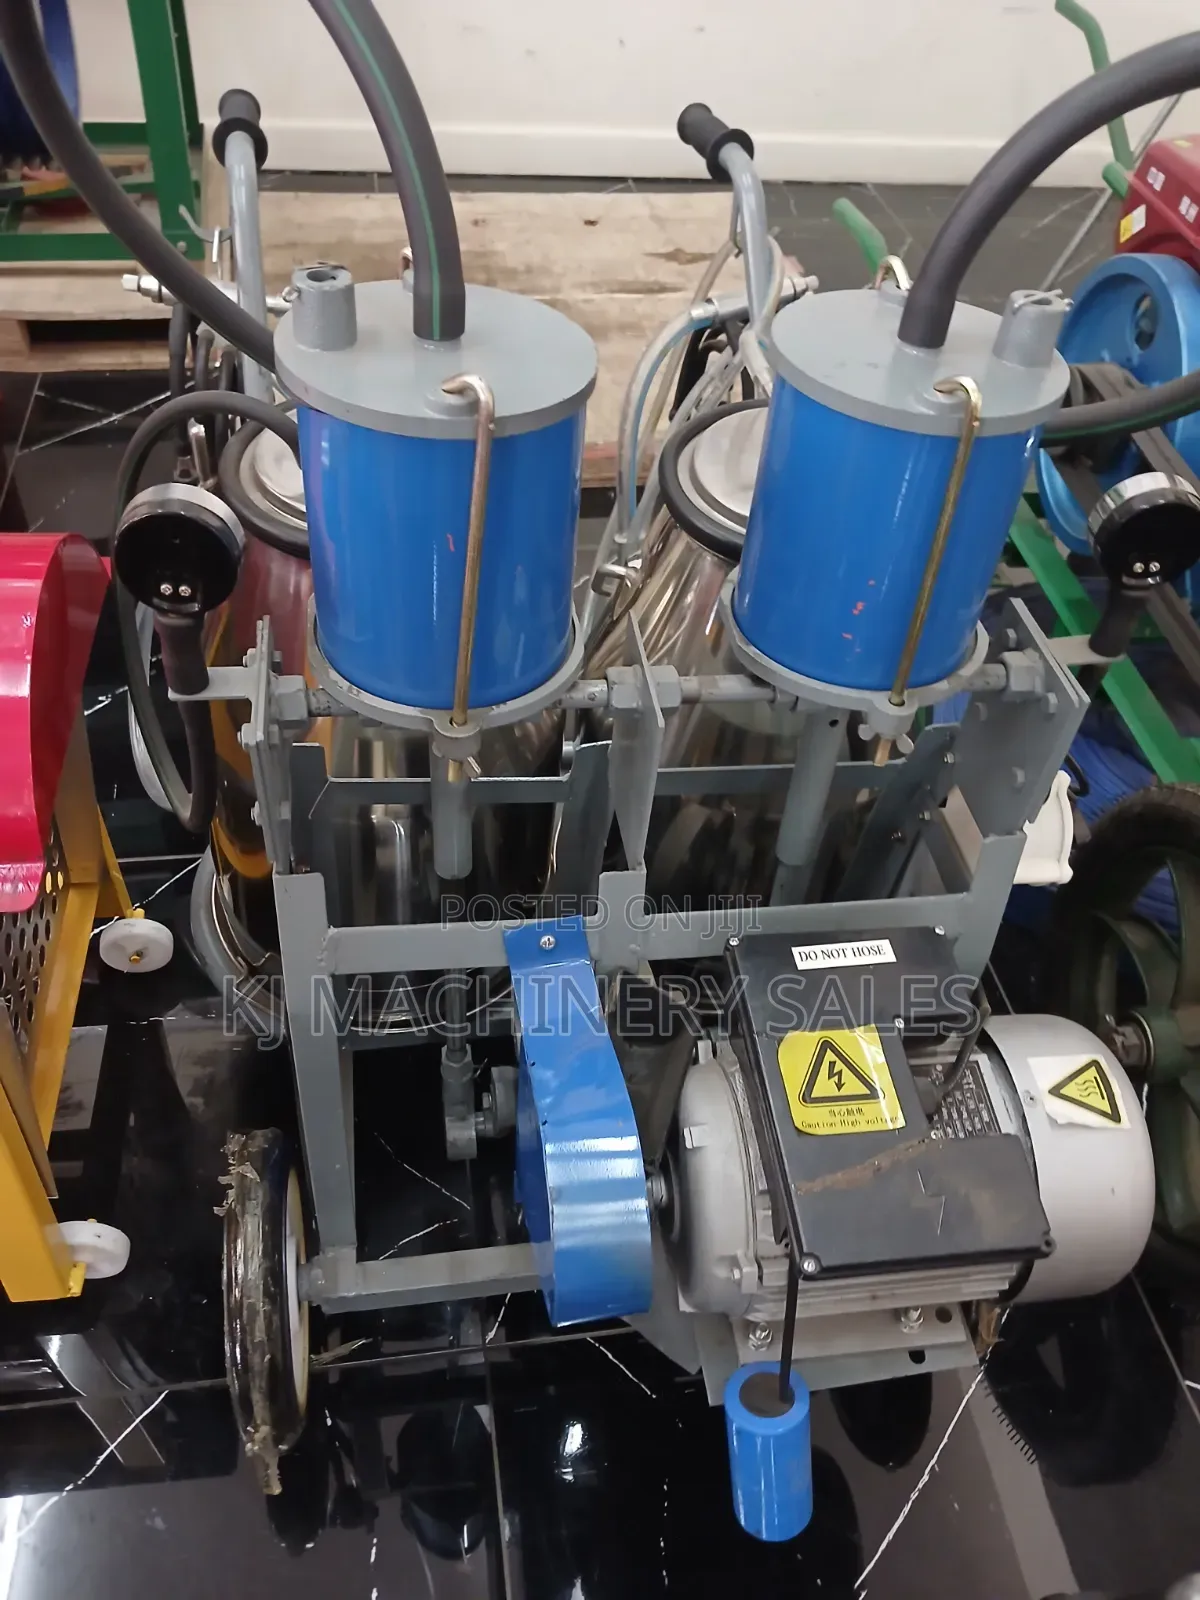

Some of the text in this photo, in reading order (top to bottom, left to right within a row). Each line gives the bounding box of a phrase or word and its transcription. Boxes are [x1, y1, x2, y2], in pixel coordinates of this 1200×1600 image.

[798, 944, 886, 962] DO NOT HOSE
